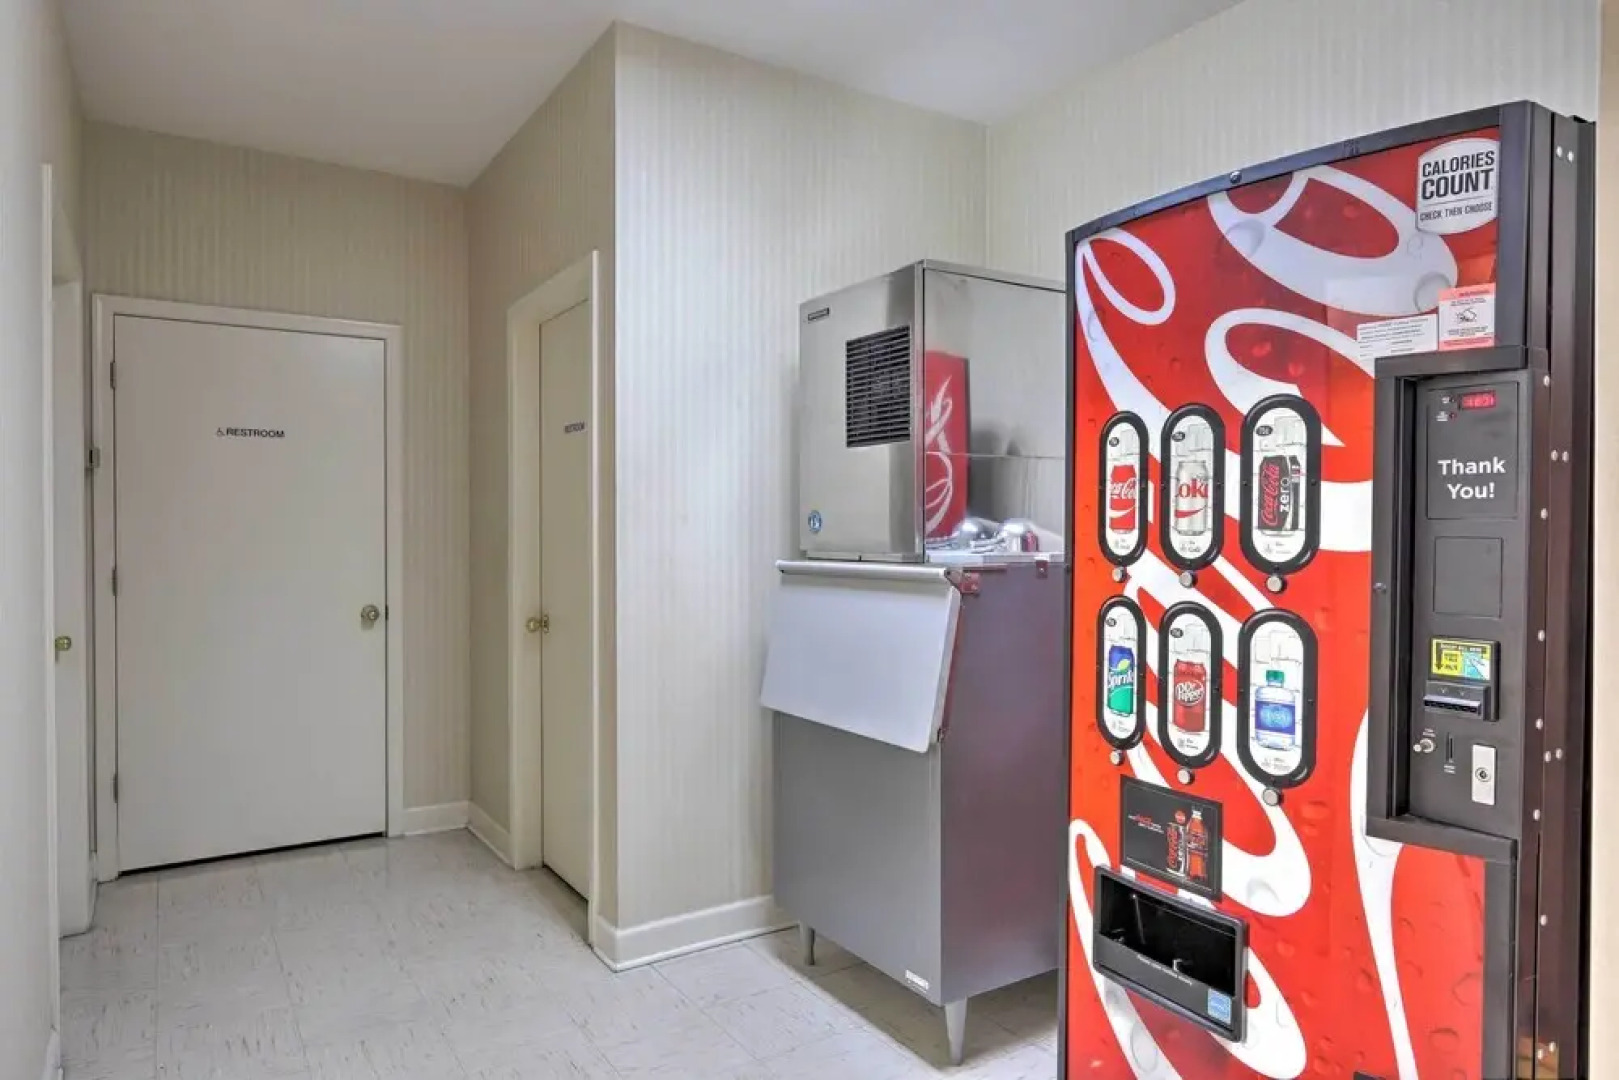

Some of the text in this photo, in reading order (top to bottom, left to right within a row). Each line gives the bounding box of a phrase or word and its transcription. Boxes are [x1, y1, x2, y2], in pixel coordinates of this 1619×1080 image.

[1422, 150, 1495, 177] CALORIES
[1421, 168, 1494, 200] COUNT
[1419, 201, 1493, 222] CHECK THEN CHOOSE
[226, 427, 285, 438] RESTROOM
[1437, 456, 1506, 475] Thank
[1280, 477, 1290, 513] zero
[1447, 482, 1495, 499] You!
